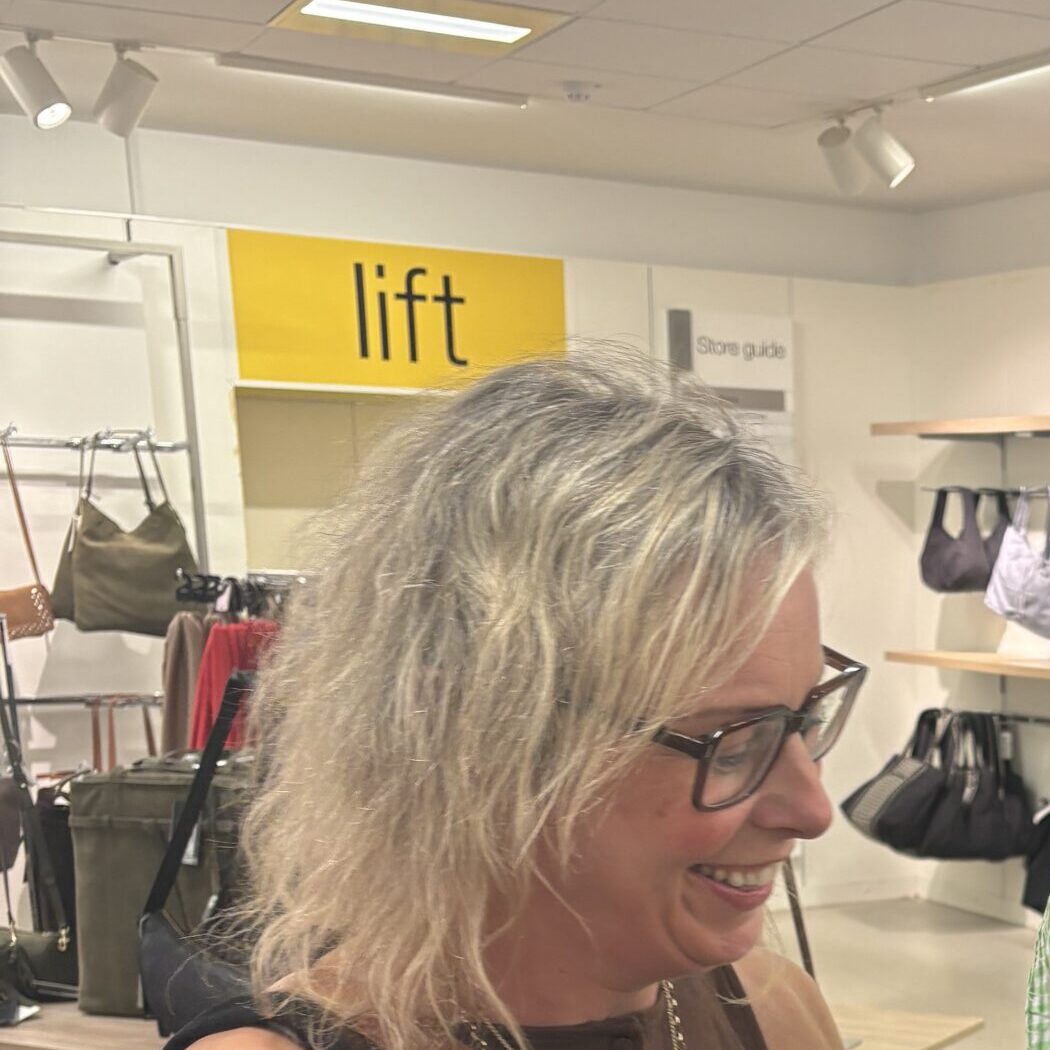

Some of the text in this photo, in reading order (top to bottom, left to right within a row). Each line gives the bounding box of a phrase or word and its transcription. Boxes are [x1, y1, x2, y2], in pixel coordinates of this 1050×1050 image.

[354, 262, 468, 366] lift
[696, 335, 787, 361] Store guide
